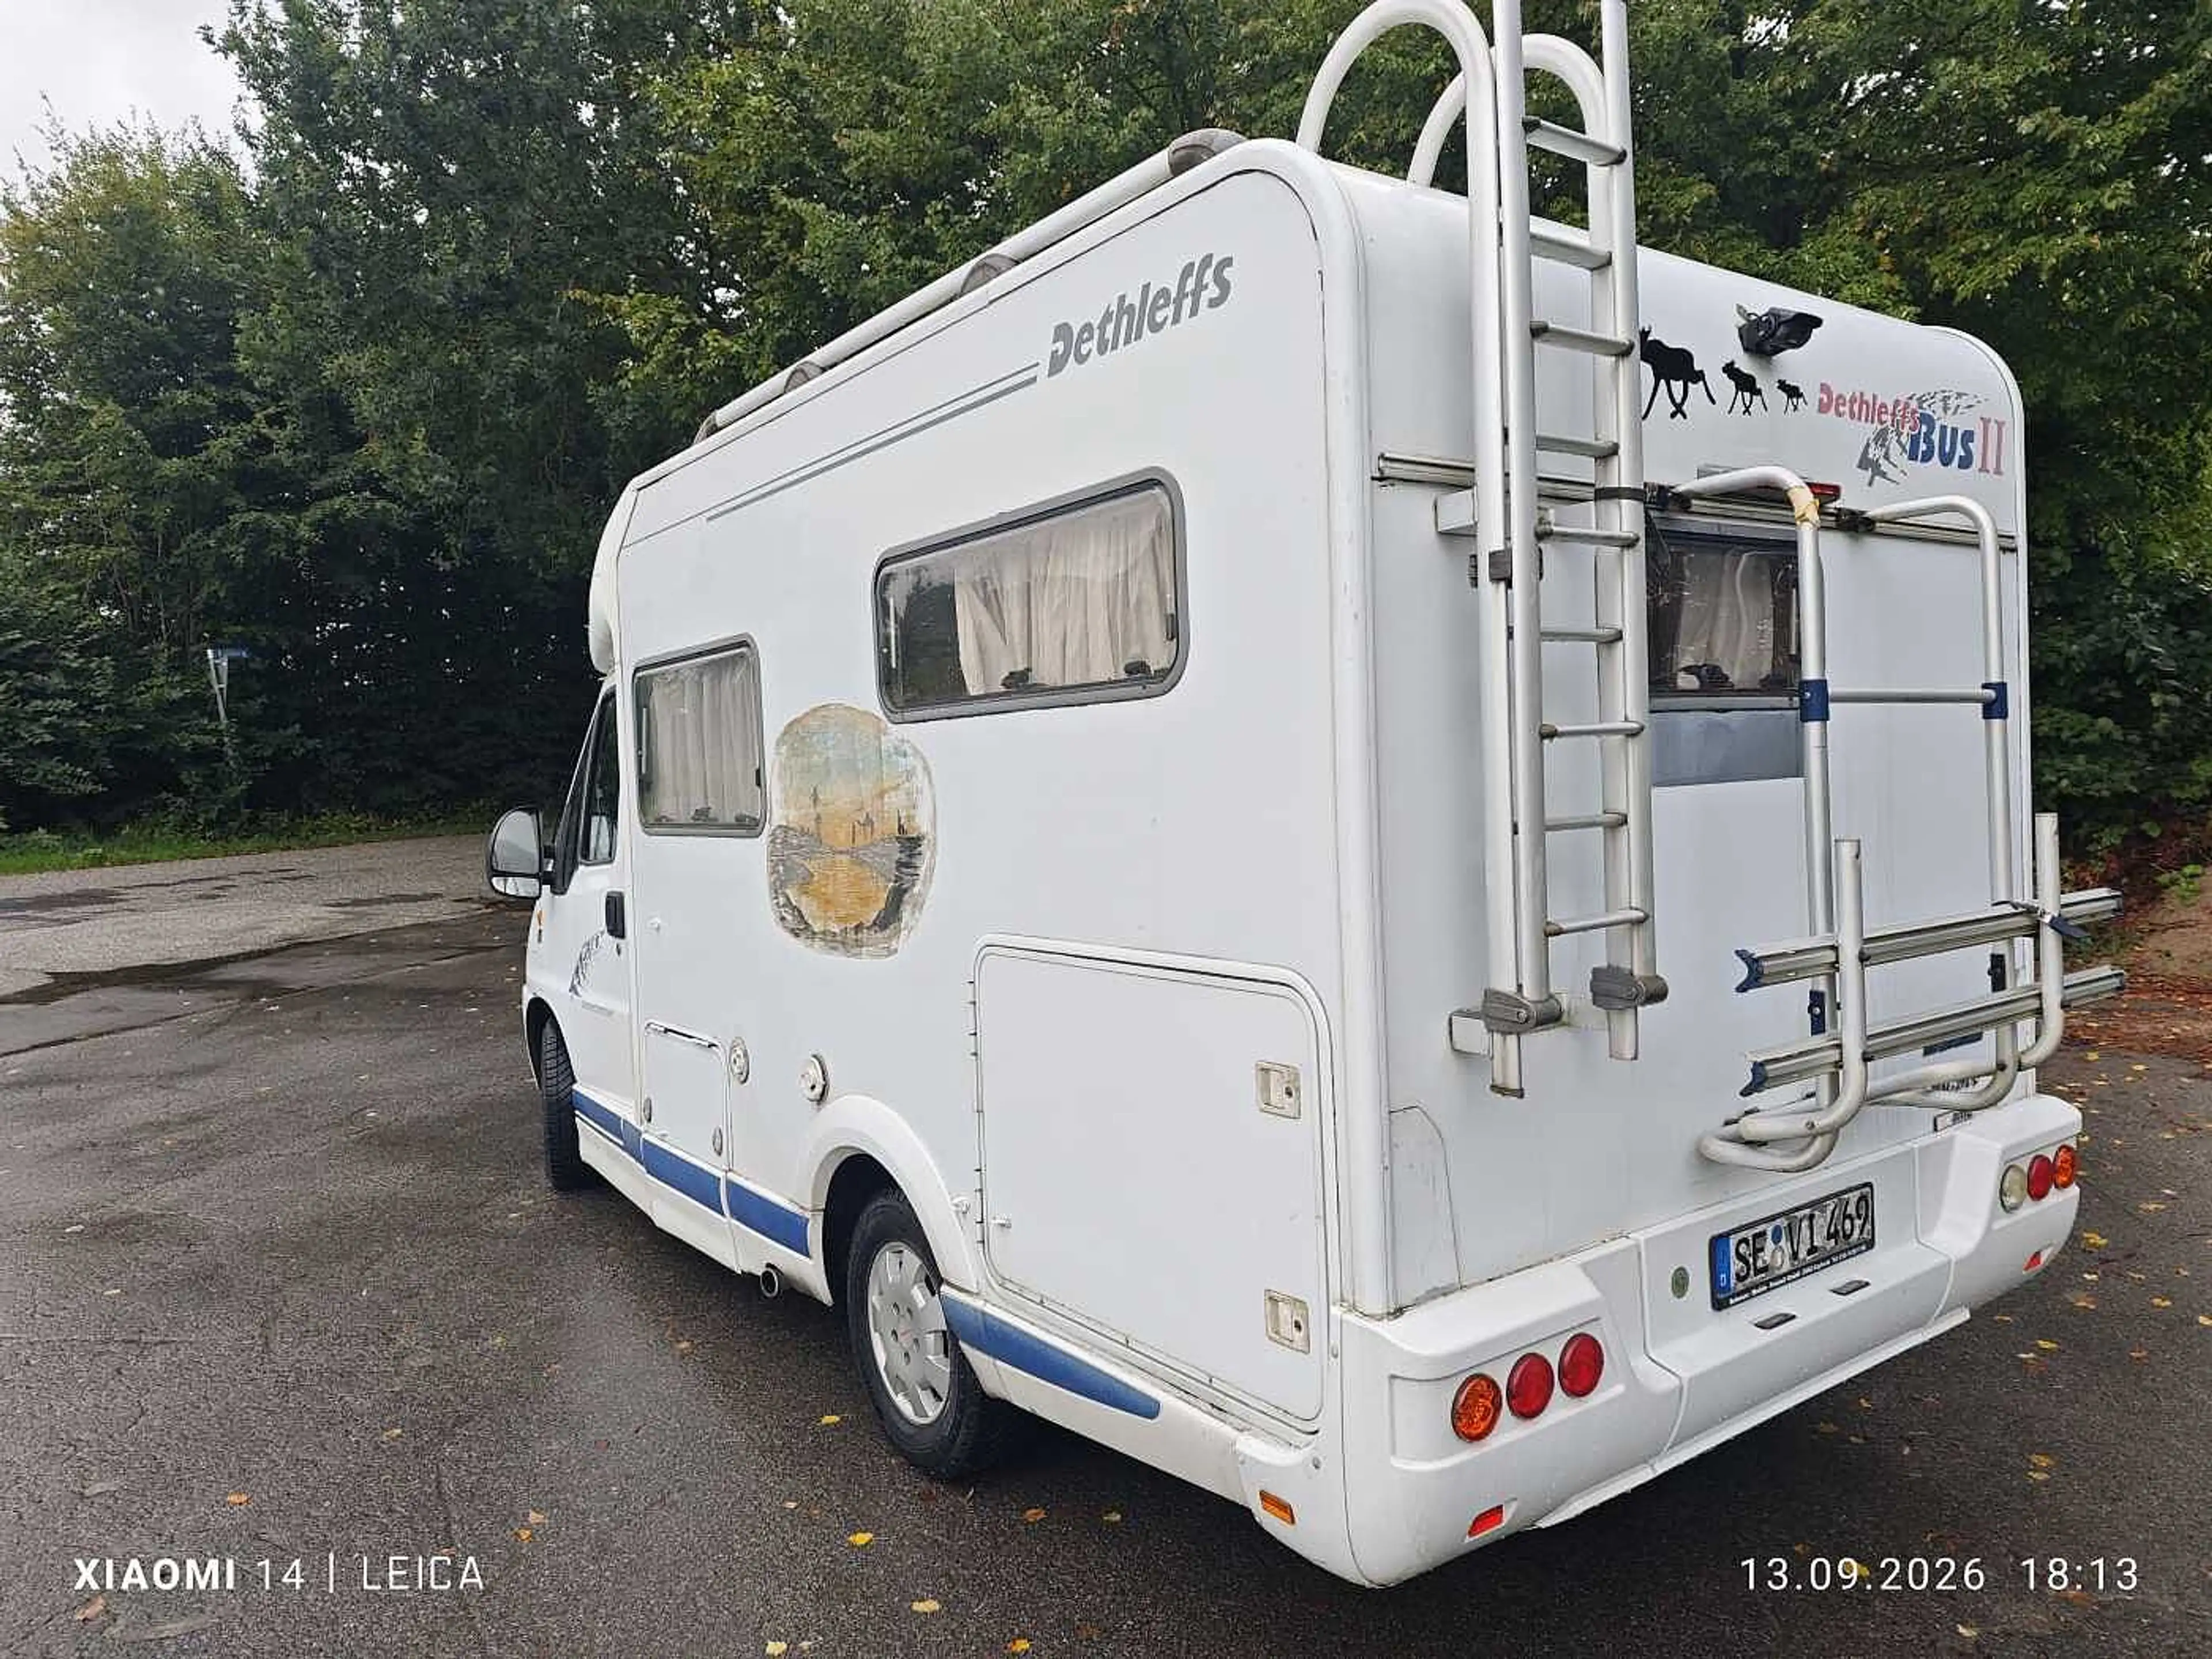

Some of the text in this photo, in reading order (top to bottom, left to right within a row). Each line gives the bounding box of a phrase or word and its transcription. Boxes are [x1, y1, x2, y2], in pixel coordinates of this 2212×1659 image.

[1047, 252, 1233, 378] Dethleffs
[1819, 382, 1920, 432] Dethleffs
[1735, 1230, 1768, 1282] SE
[1787, 1213, 1818, 1260] VI
[1827, 1194, 1870, 1246] 469
